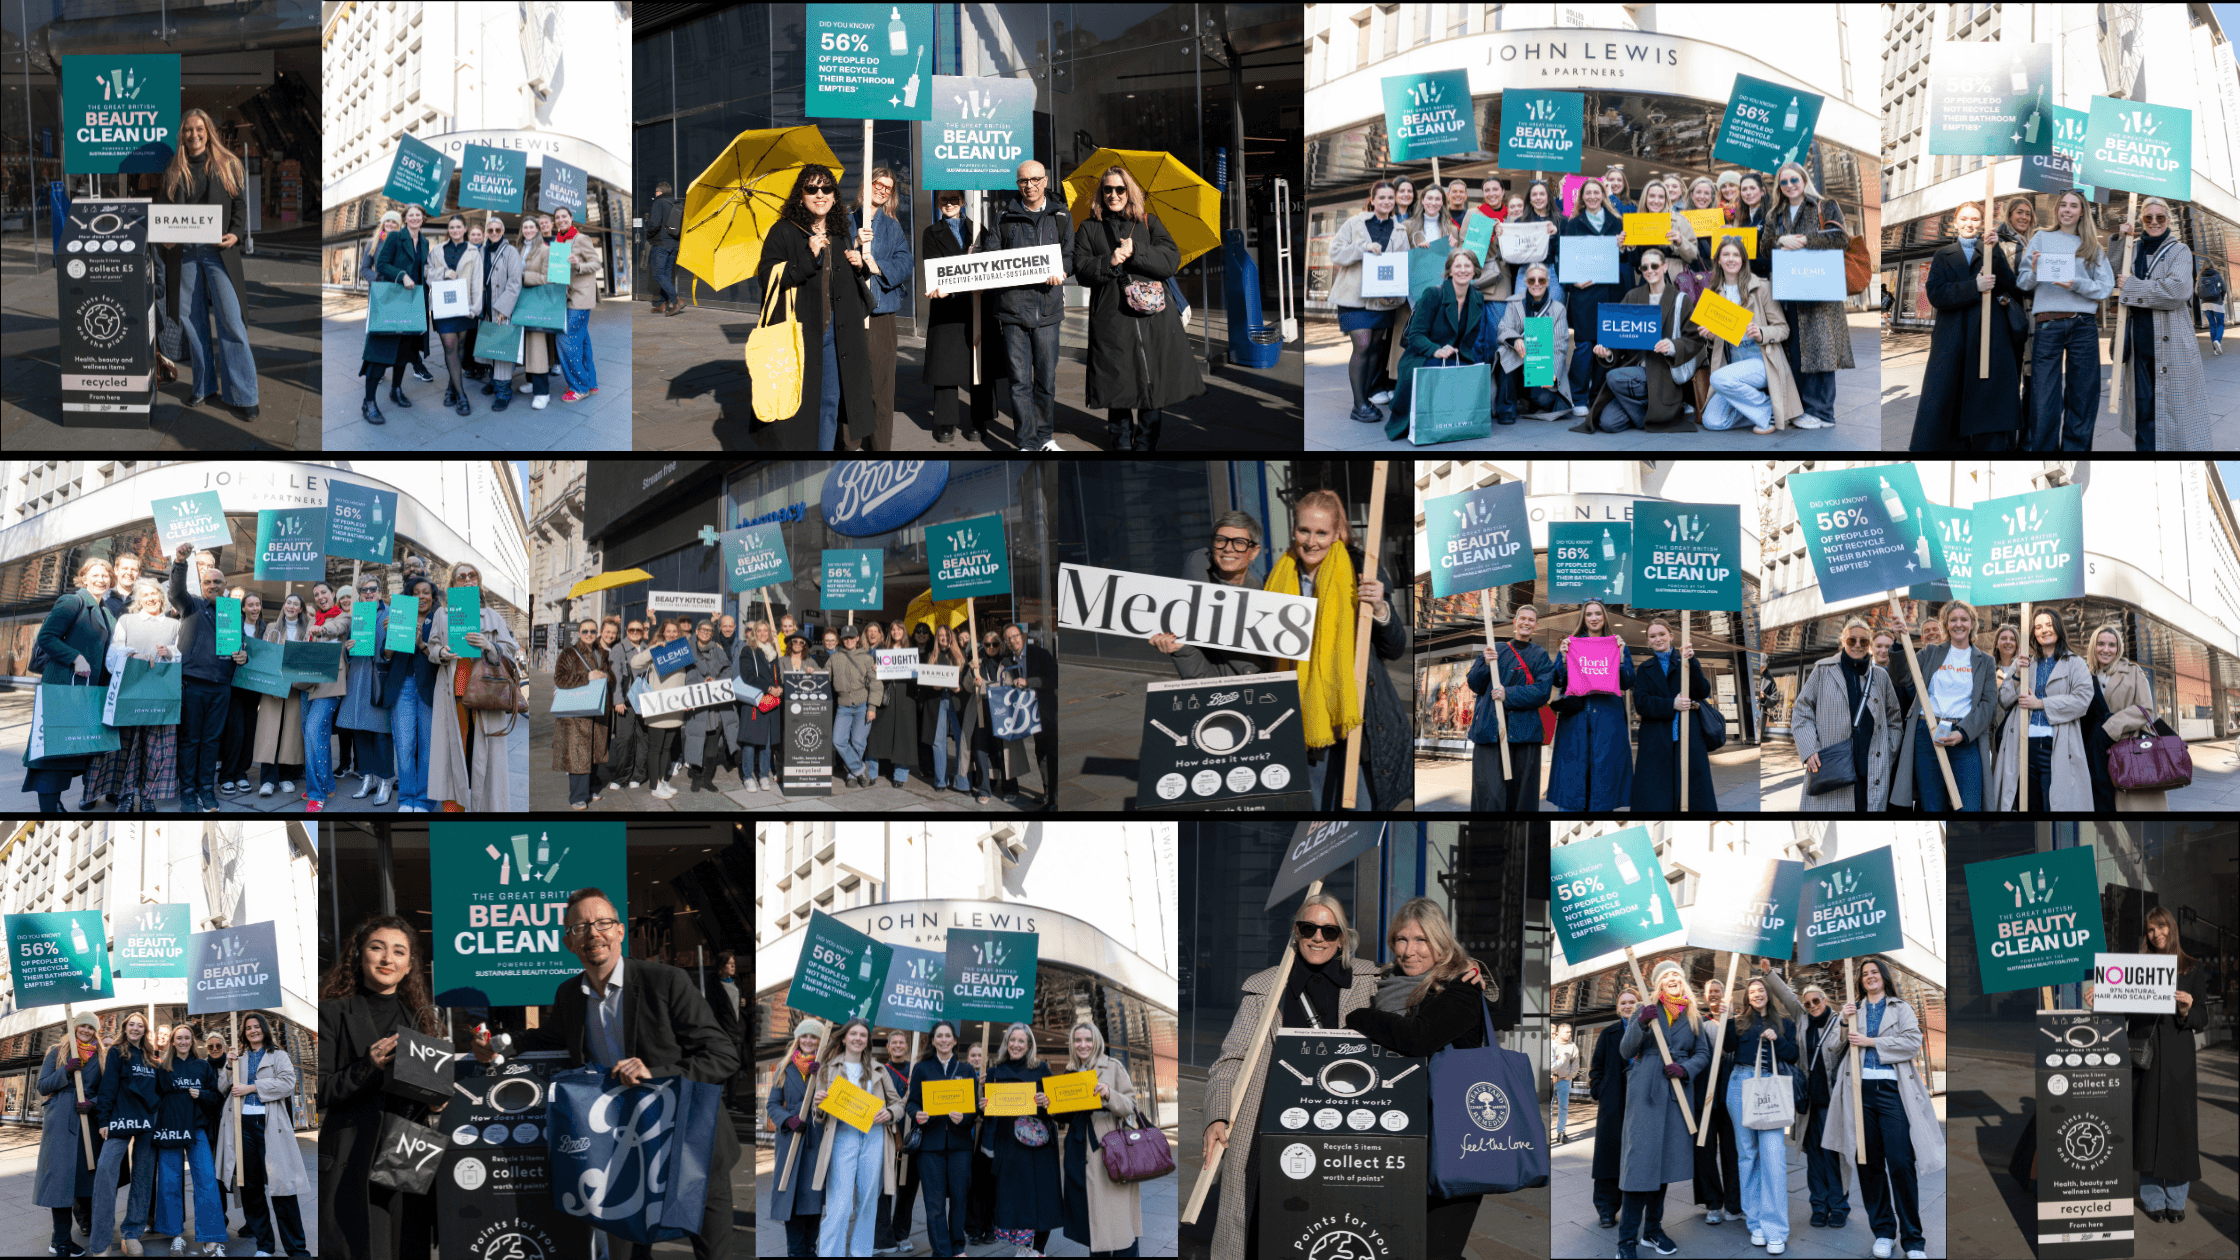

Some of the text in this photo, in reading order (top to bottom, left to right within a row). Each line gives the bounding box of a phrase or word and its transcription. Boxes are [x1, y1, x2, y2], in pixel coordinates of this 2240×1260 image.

[849, 22, 875, 31] KNOW?
[821, 33, 869, 52] 56%
[819, 55, 880, 65] OF PEOPLE DO
[1486, 42, 1678, 67] JOHN LEWIS
[819, 65, 878, 75] NOT RECYCLE
[1541, 68, 1625, 77] & PARTNERS
[819, 75, 895, 85] THEIR BATHROOM
[86, 111, 159, 126] BEAUTY
[1402, 109, 1457, 126] BEAUTY
[1736, 103, 1770, 124] 56%
[77, 127, 168, 143] CLEAN UP
[1396, 119, 1467, 139] CLEAN UP
[1516, 126, 1568, 140] BEAUTY
[943, 130, 1013, 145] BEAUTY
[1508, 137, 1573, 151] CLEAN UP
[934, 145, 1022, 160] CLEAN UP
[2105, 137, 2172, 158] BEAUTY
[401, 156, 424, 174] 56%
[2094, 149, 2180, 172] CLEAN UP
[473, 174, 513, 187] BEAUTY
[467, 182, 518, 197] CLEAN UP
[154, 216, 214, 224] BRAMLEY
[937, 254, 1051, 279] BEAUTY KITCHEN
[1602, 319, 1657, 333] ELEMIS
[82, 377, 128, 388] recycled
[335, 504, 362, 520] 56%
[1816, 507, 1869, 531] 56%
[166, 522, 221, 540] CLEAN UP
[169, 516, 212, 531] BEAUTY
[1447, 530, 1510, 554] BEAUTY
[1820, 527, 1884, 544] OF PEOPLE DO
[268, 541, 313, 552] BEAUTY
[1557, 547, 1590, 560] 56%
[1823, 537, 1886, 554] NOT RECYCLE
[1990, 538, 2061, 561] BEAUTY
[262, 551, 319, 562] CLEAN UP
[736, 551, 776, 567] BEAUTY
[942, 553, 992, 570] BEAUTY
[1440, 542, 1521, 569] CLEAN UP
[1652, 550, 1721, 567] BEAUTY
[1826, 544, 1905, 565] THEIR BATHROOM
[734, 557, 783, 577] CLEAN UP
[828, 567, 852, 578] 56%
[937, 563, 1000, 581] CLEAN UP
[1981, 556, 2042, 577] CLEAN
[2044, 553, 2070, 570] UP
[1644, 565, 1730, 582] CLEAN UP
[655, 595, 716, 605] BEAUTY KITCHEN
[1058, 566, 1312, 657] Medik8
[656, 646, 690, 666] ELEMIS
[876, 654, 918, 666] NOUGHTY
[1579, 656, 1609, 667] floral
[1580, 666, 1610, 675] street
[642, 680, 736, 716] Medik8
[1206, 691, 1240, 707] Boots
[1175, 752, 1271, 768] How does it work?
[472, 892, 495, 901] THE
[499, 891, 535, 901] GREAT
[1557, 875, 1605, 902] 56%
[470, 902, 569, 928] BEAUT
[1812, 896, 1877, 923] BEAUTY
[866, 912, 1036, 936] JOHN LEWIS
[1806, 909, 1888, 938] CLEAN UP
[1997, 911, 2077, 939] BEAUTY
[20, 941, 60, 957] 56%
[127, 937, 177, 948] BEAUTY
[454, 930, 560, 955] CLEAN
[1991, 929, 2090, 958] CLEAN UP
[121, 947, 183, 958] CLEAN UP
[812, 944, 847, 971] 56%
[202, 961, 261, 979] BEAUTY
[475, 968, 550, 977] SUSTAINABLE BEAUTY
[2095, 965, 2175, 986] NOUGHTY
[196, 973, 269, 992] CLEAN UP
[961, 972, 1019, 986] BEAUTY
[953, 984, 1026, 999] CLEAN UP
[1333, 1043, 1368, 1056] Boots
[2072, 1079, 2105, 1089] collect
[2108, 1078, 2120, 1088] £5
[1300, 1097, 1322, 1105] How
[1487, 1086, 1505, 1105] YARD
[1472, 1110, 1506, 1127] REMEDIES
[1323, 1142, 1383, 1152] Recycle 5 items
[1459, 1133, 1488, 1160] feel
[1486, 1137, 1508, 1152] the
[1323, 1154, 1406, 1170] collect £5
[492, 1162, 544, 1179] collect
[1322, 1174, 1345, 1182] worth
[1346, 1174, 1355, 1182] of
[2060, 1201, 2111, 1216] recycled
[1344, 1212, 1368, 1228] for
[1368, 1229, 1389, 1256] you
